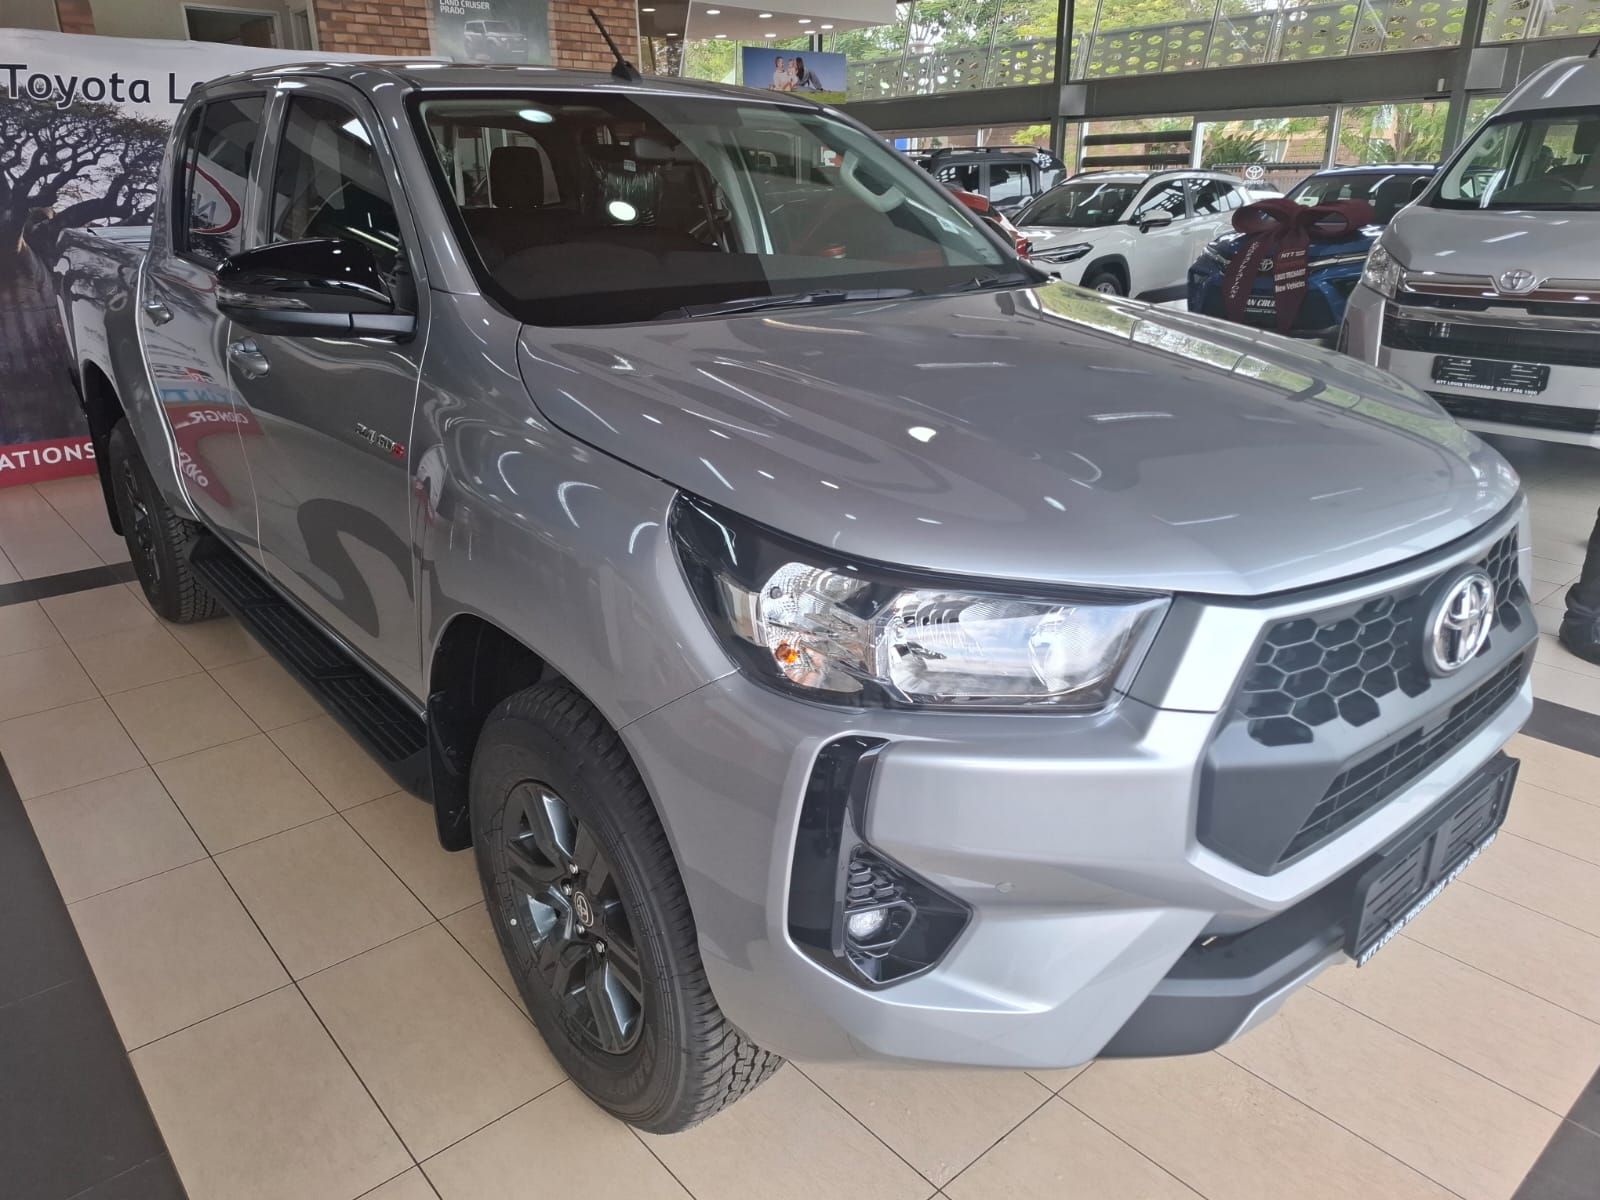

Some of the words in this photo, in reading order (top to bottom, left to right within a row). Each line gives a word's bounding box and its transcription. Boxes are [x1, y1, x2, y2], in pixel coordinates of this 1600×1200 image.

[440, 5, 465, 15] PRADO
[460, 0, 490, 10] CRUISER
[0, 64, 151, 109] Toyota
[1275, 284, 1287, 293] New
[1287, 281, 1306, 290] Vehicles
